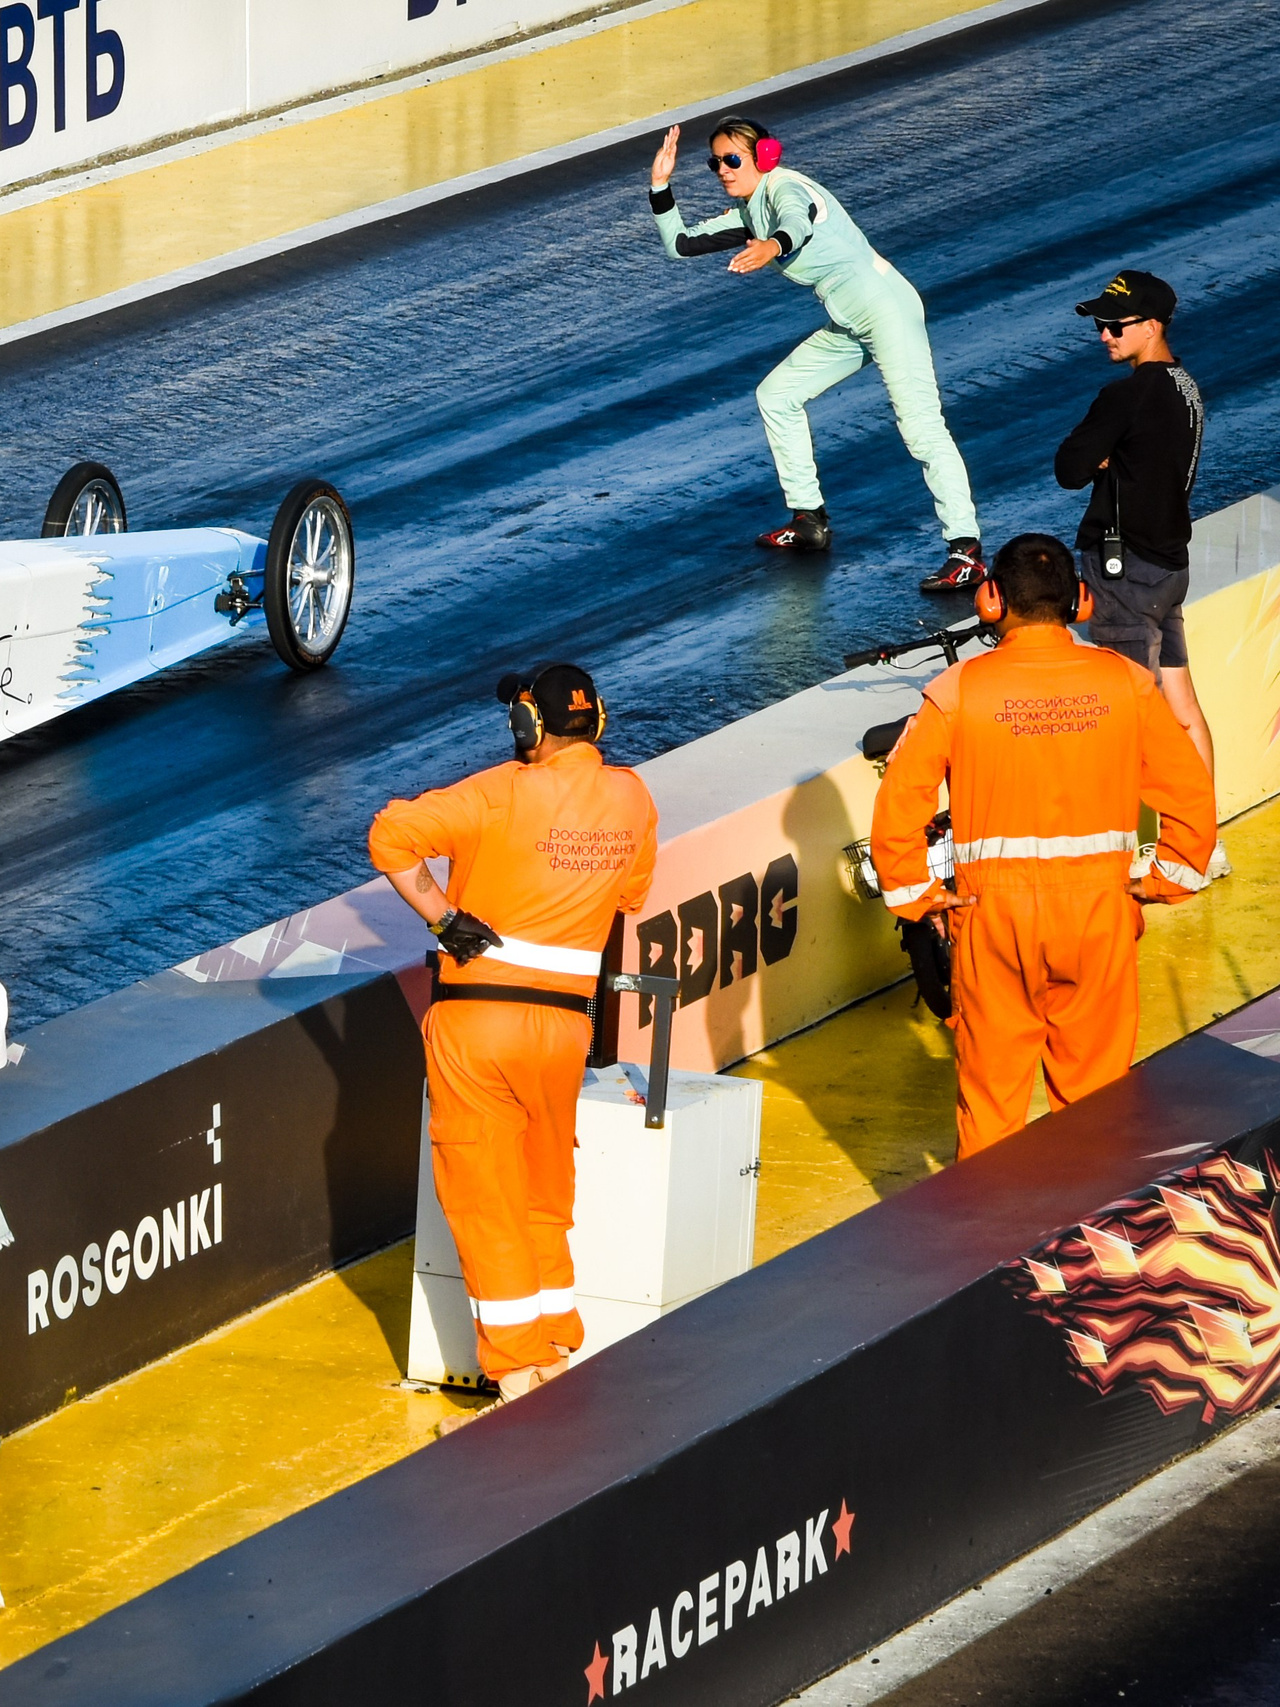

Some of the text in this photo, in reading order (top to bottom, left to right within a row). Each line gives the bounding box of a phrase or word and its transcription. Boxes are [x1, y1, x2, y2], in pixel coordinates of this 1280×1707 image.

[1004, 693, 1098, 712] российская
[994, 705, 1110, 723] автомобильная
[1011, 719, 1098, 737] федерация
[548, 827, 633, 843] российская
[535, 840, 636, 857] автомобильная
[548, 855, 627, 873] федерация
[636, 853, 798, 1030] RDRC
[28, 1183, 223, 1336] ROSGONKI
[611, 1508, 829, 1694] RACEPARK
